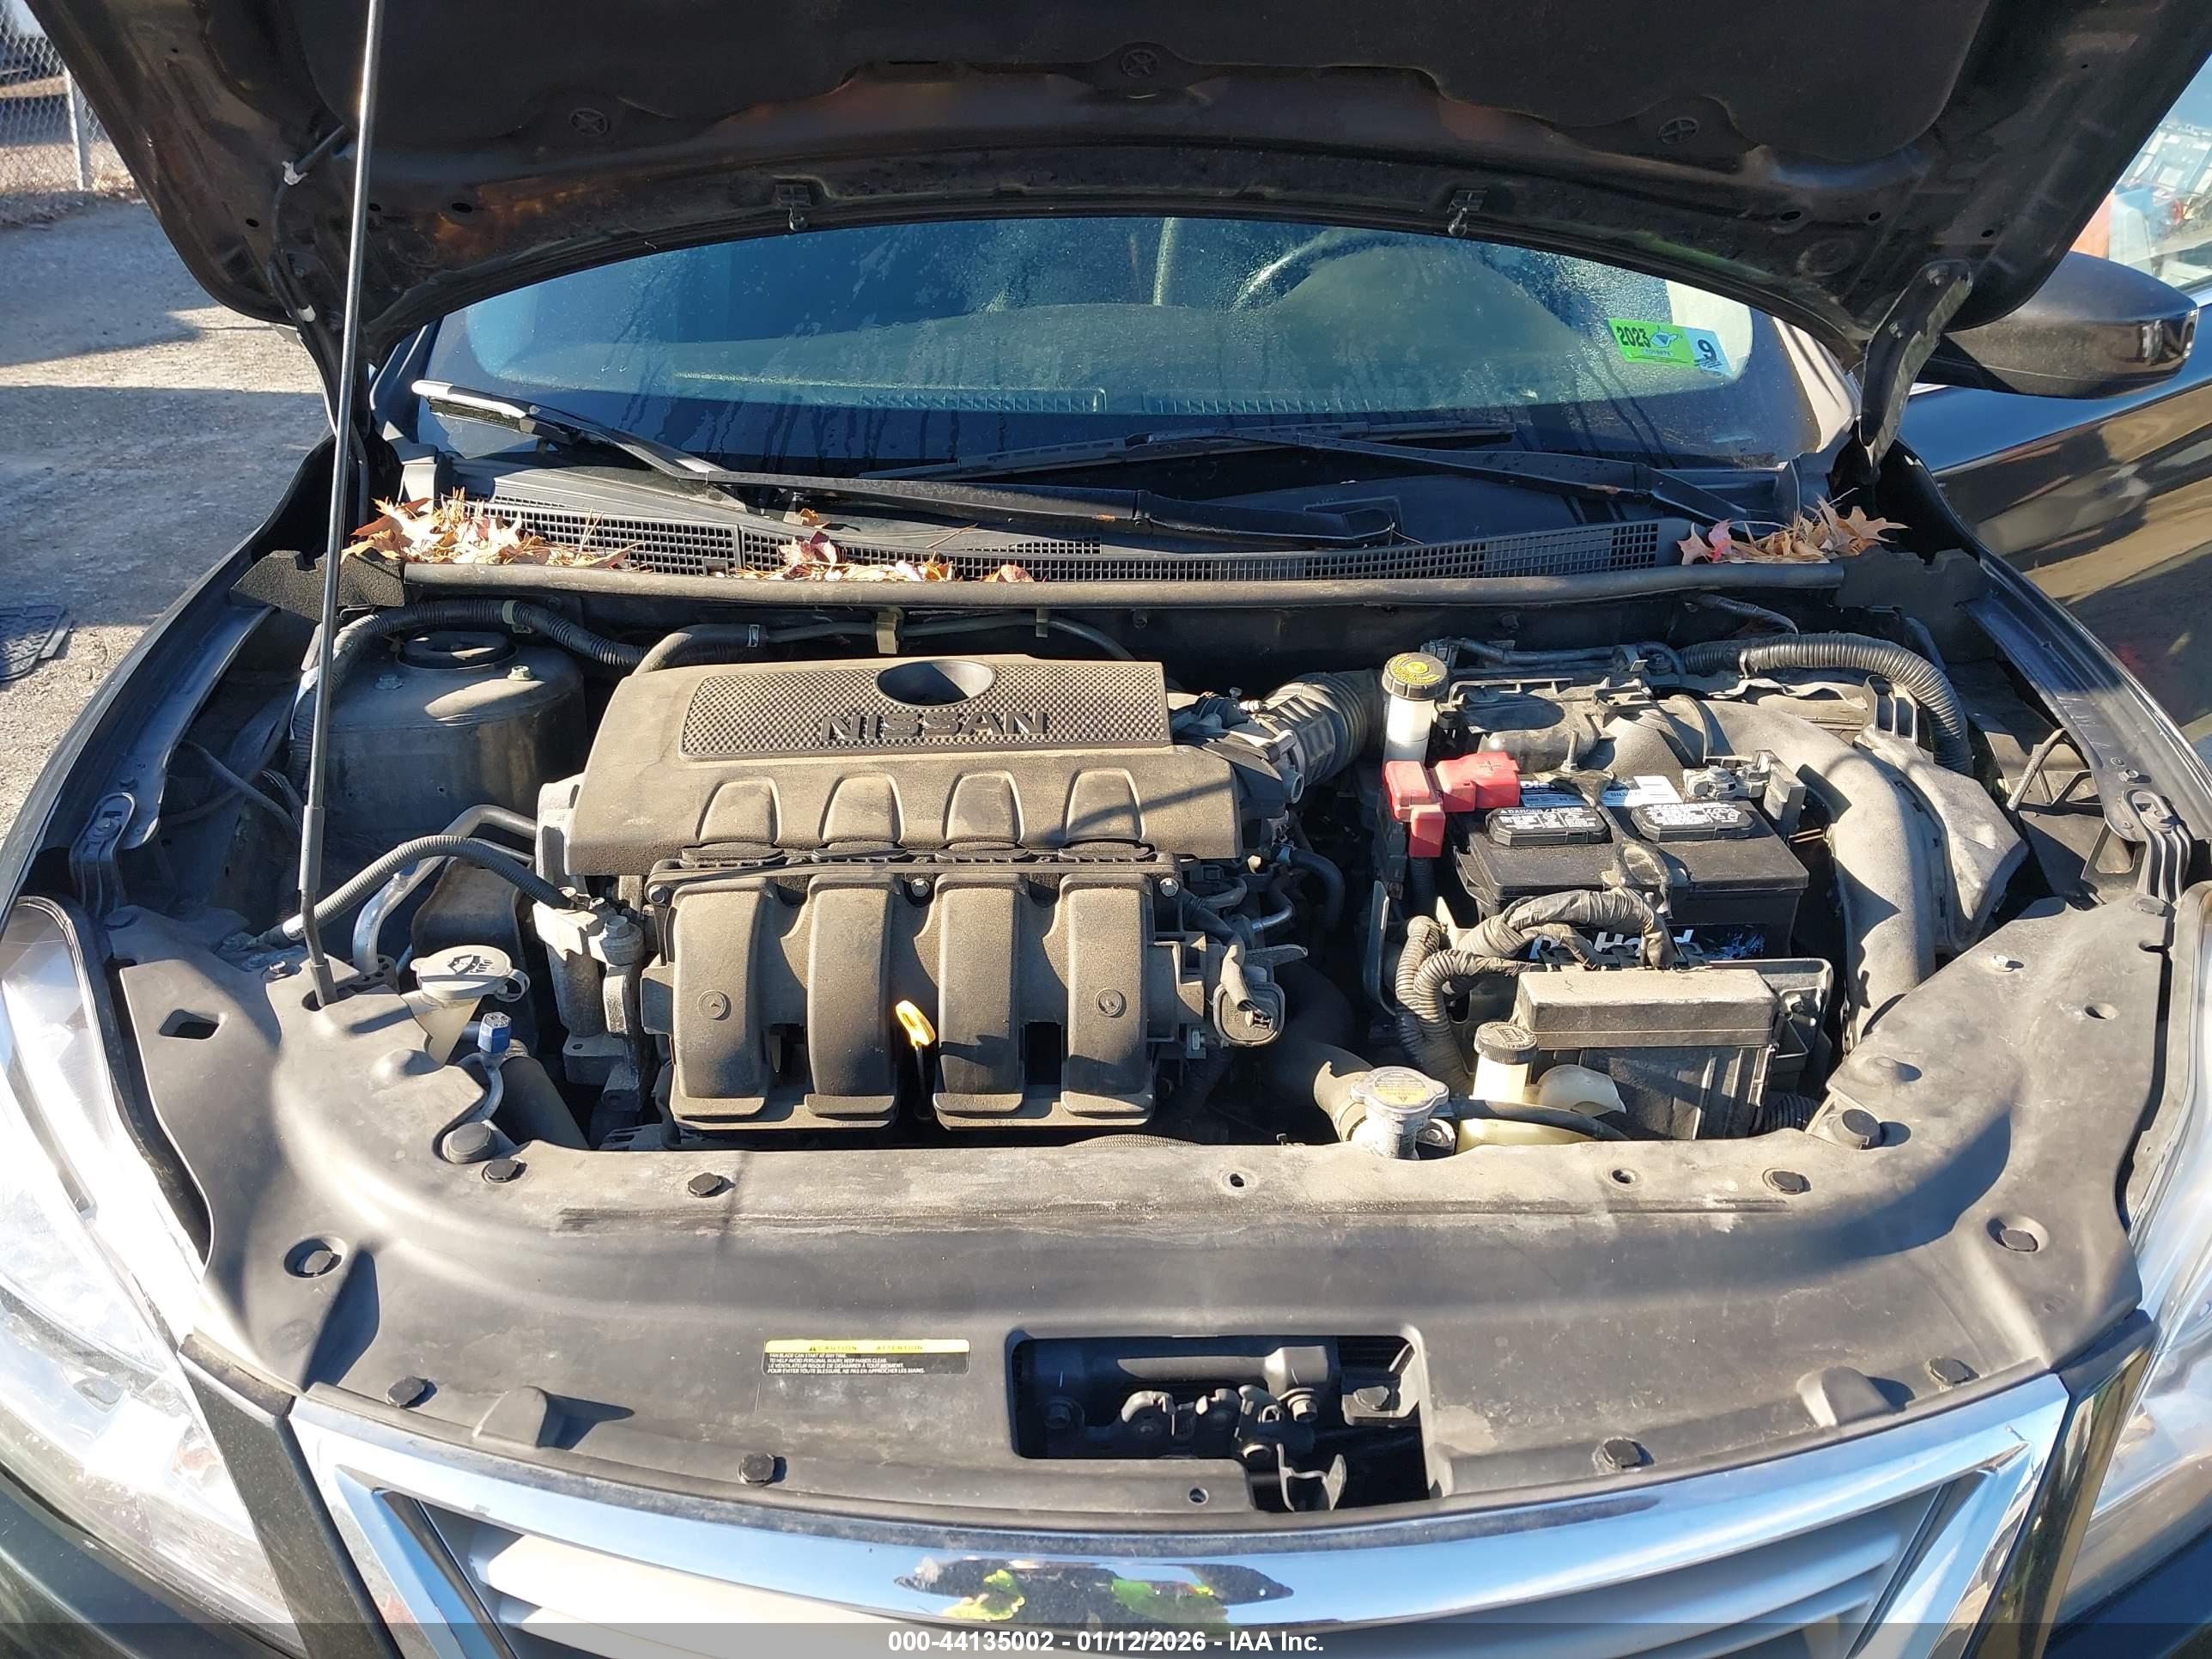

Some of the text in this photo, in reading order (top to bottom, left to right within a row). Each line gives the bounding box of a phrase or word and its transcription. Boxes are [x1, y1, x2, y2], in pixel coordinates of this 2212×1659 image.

[1616, 326, 1651, 348] 2023
[1698, 339, 1717, 362] 9
[820, 711, 1048, 740] NISSAN
